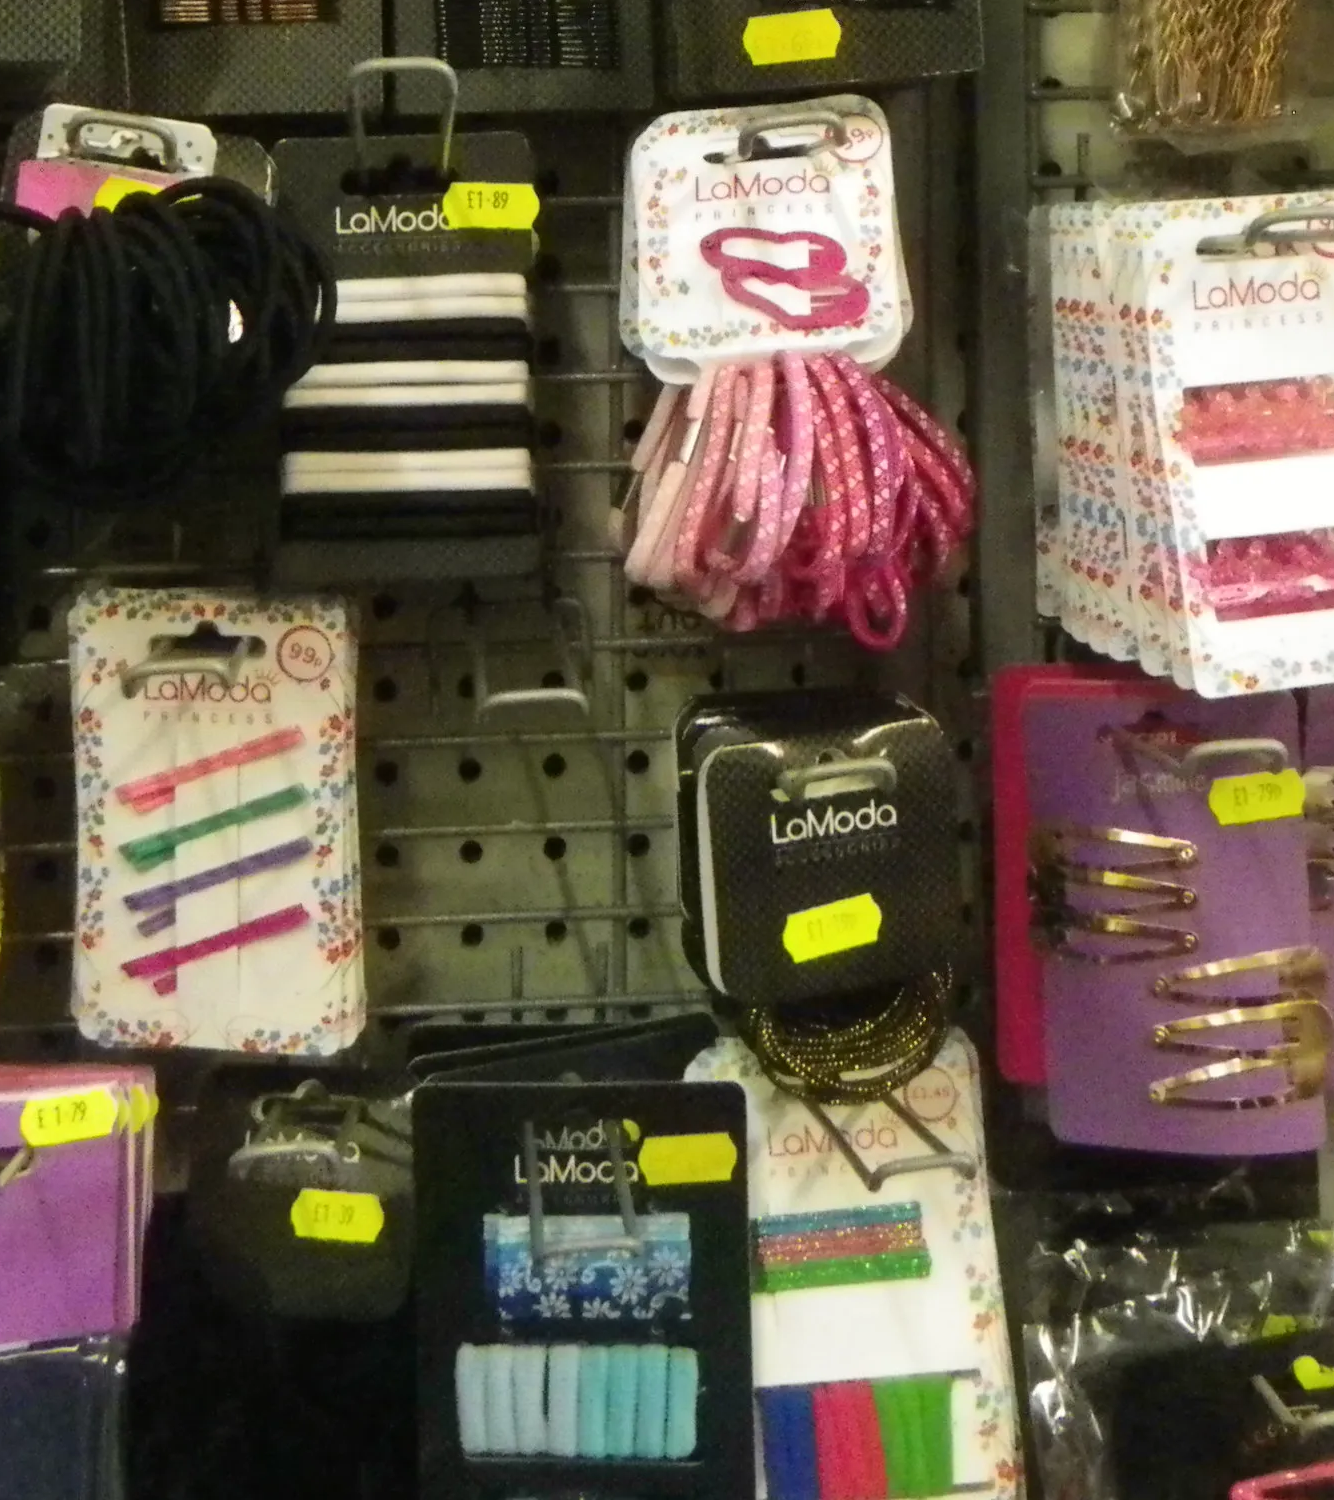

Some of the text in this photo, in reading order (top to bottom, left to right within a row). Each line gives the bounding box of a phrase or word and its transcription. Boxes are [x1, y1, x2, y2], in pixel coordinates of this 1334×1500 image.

[694, 169, 831, 203] LaModa
[336, 204, 453, 235] LaModa
[694, 204, 835, 221] PRINCESS
[1192, 273, 1320, 311] LaModa
[1193, 311, 1325, 332] PRINCESS
[287, 642, 324, 668] 99p
[143, 673, 273, 704] LaModa
[770, 800, 898, 845] LaModa
